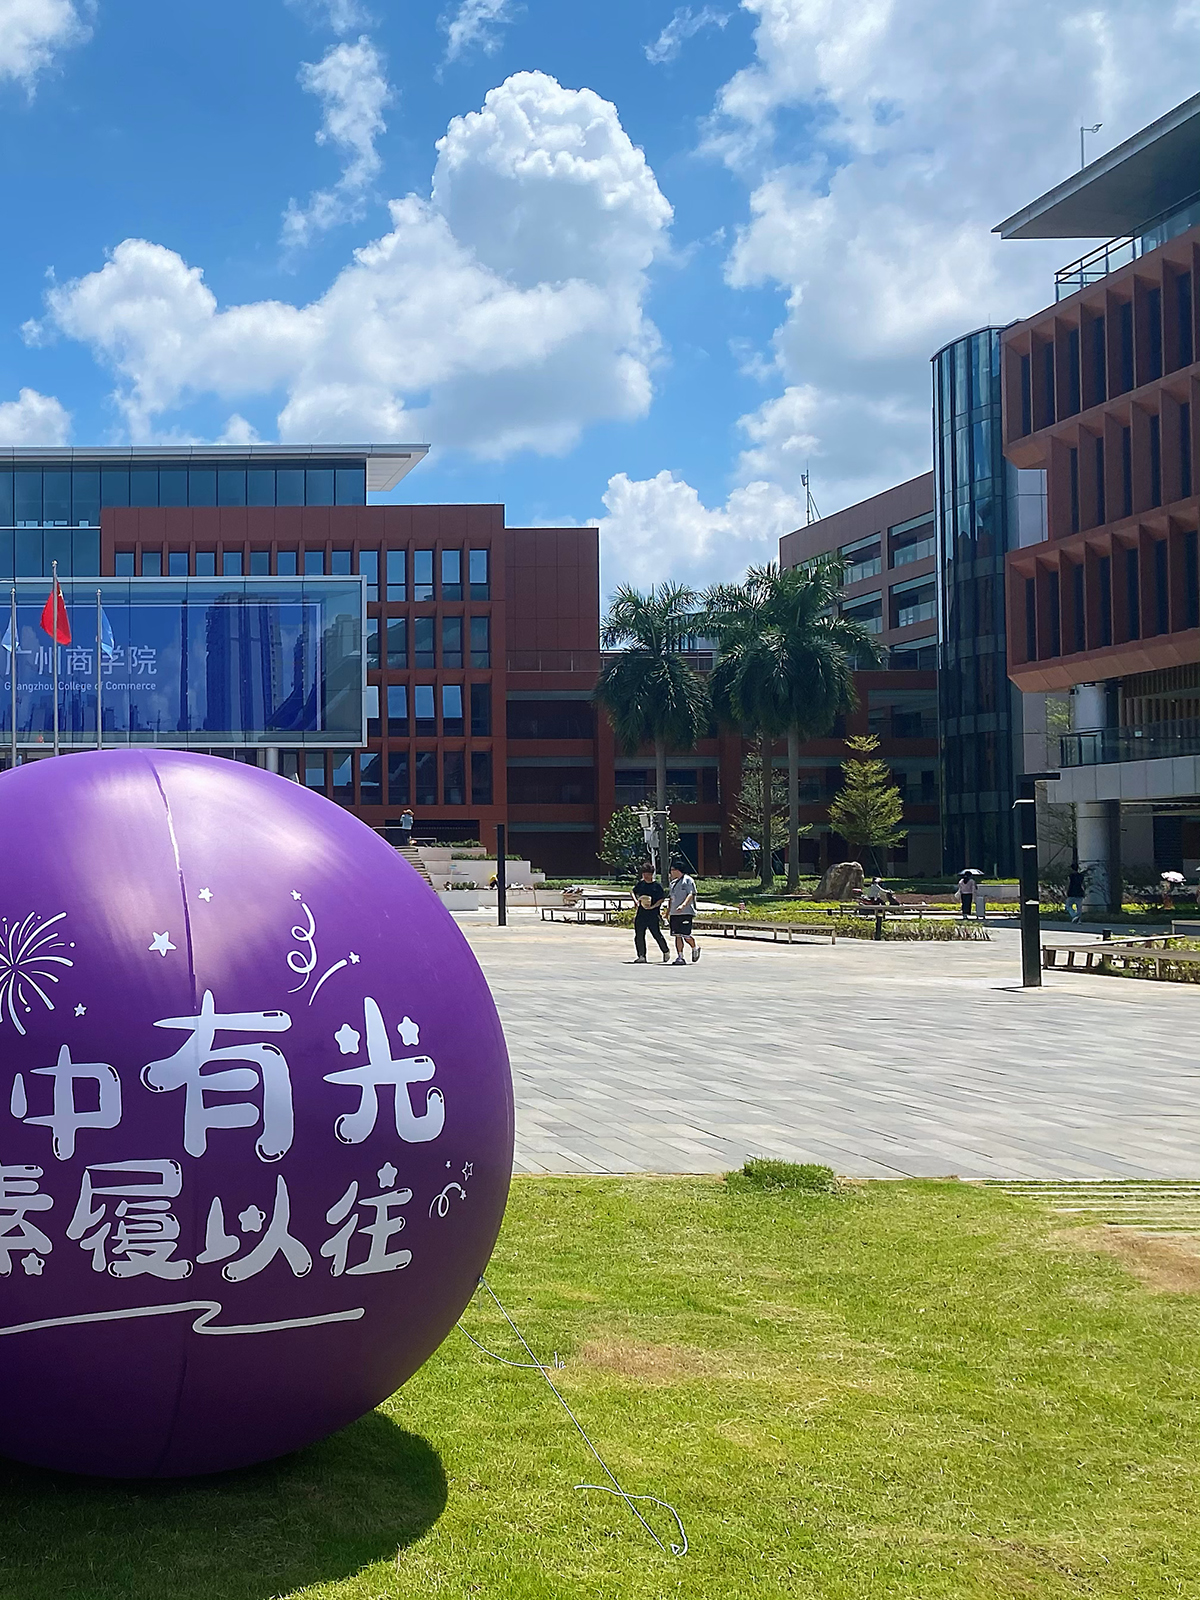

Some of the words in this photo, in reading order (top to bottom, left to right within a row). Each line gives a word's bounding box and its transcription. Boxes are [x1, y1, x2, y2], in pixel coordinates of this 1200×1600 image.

[5, 645, 157, 675] 广州商学院
[4, 681, 54, 692] Gangzhou
[58, 681, 92, 692] College
[105, 681, 156, 690] Commerce
